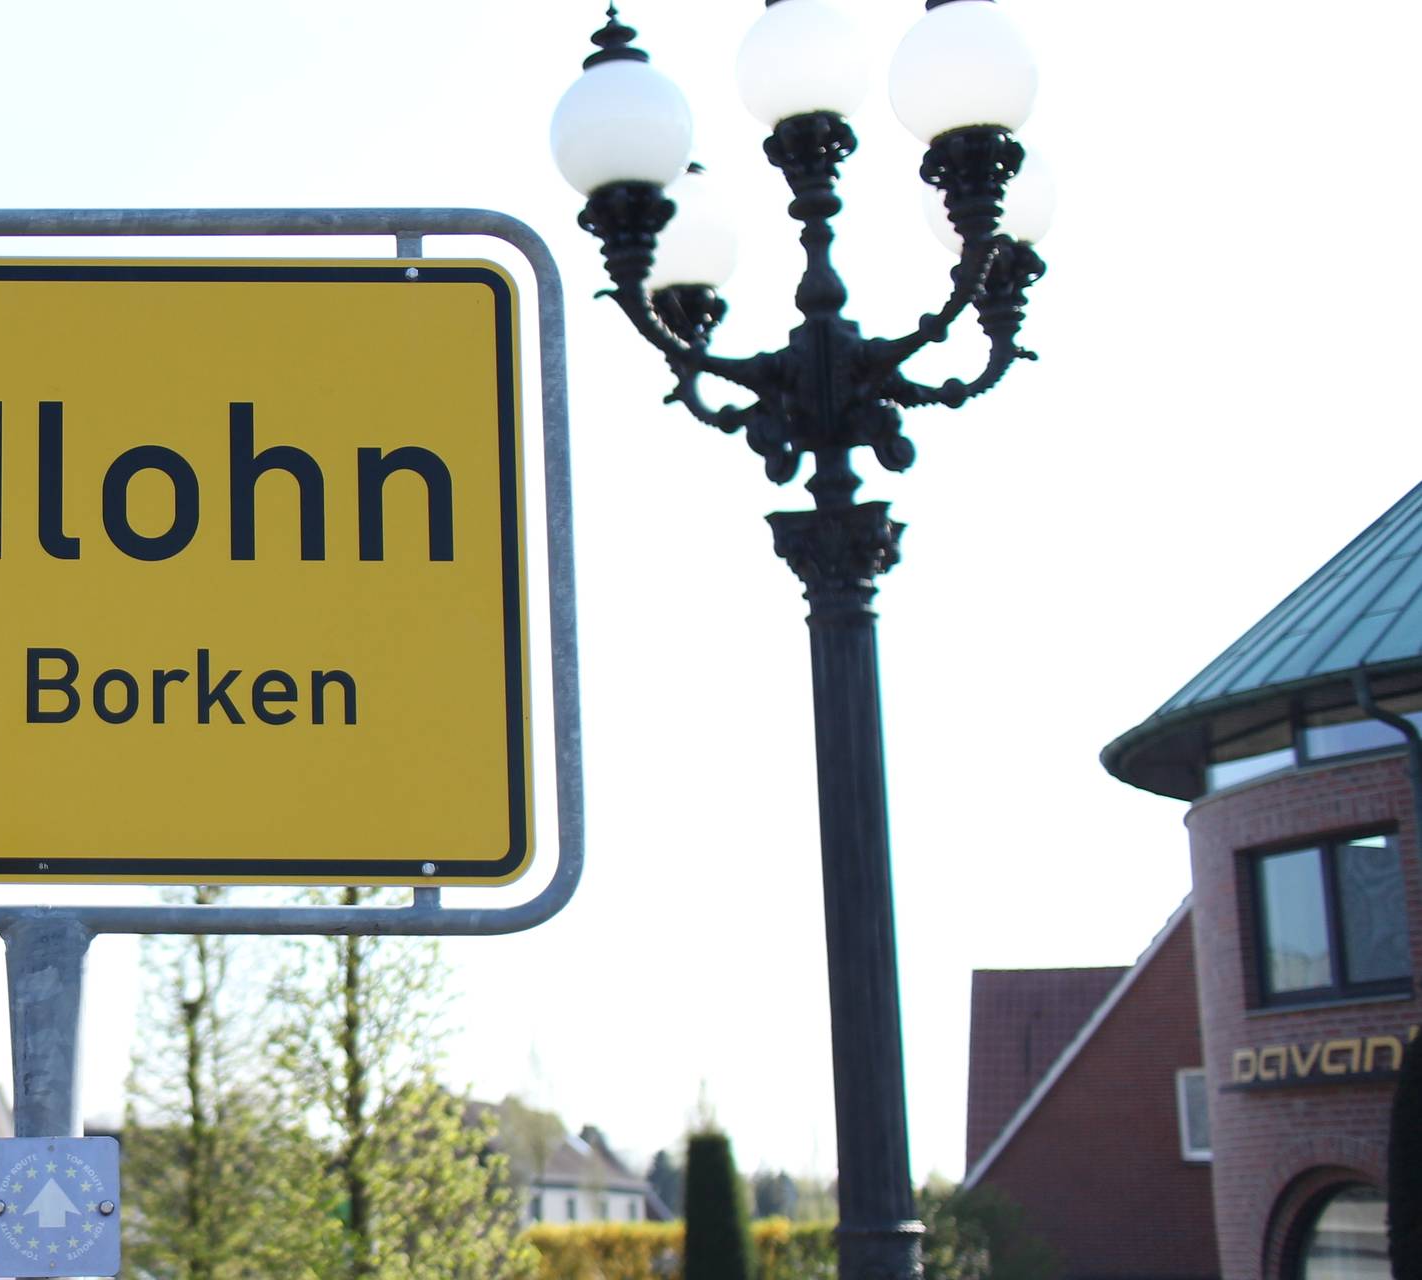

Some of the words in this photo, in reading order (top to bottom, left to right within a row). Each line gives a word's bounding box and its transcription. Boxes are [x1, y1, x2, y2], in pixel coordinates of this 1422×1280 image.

[26, 647, 358, 727] Borken
[0, 1174, 12, 1192] TOP
[10, 1154, 38, 1176] ROUTE
[65, 1152, 83, 1165] TOP
[82, 1164, 105, 1192] ROUTE
